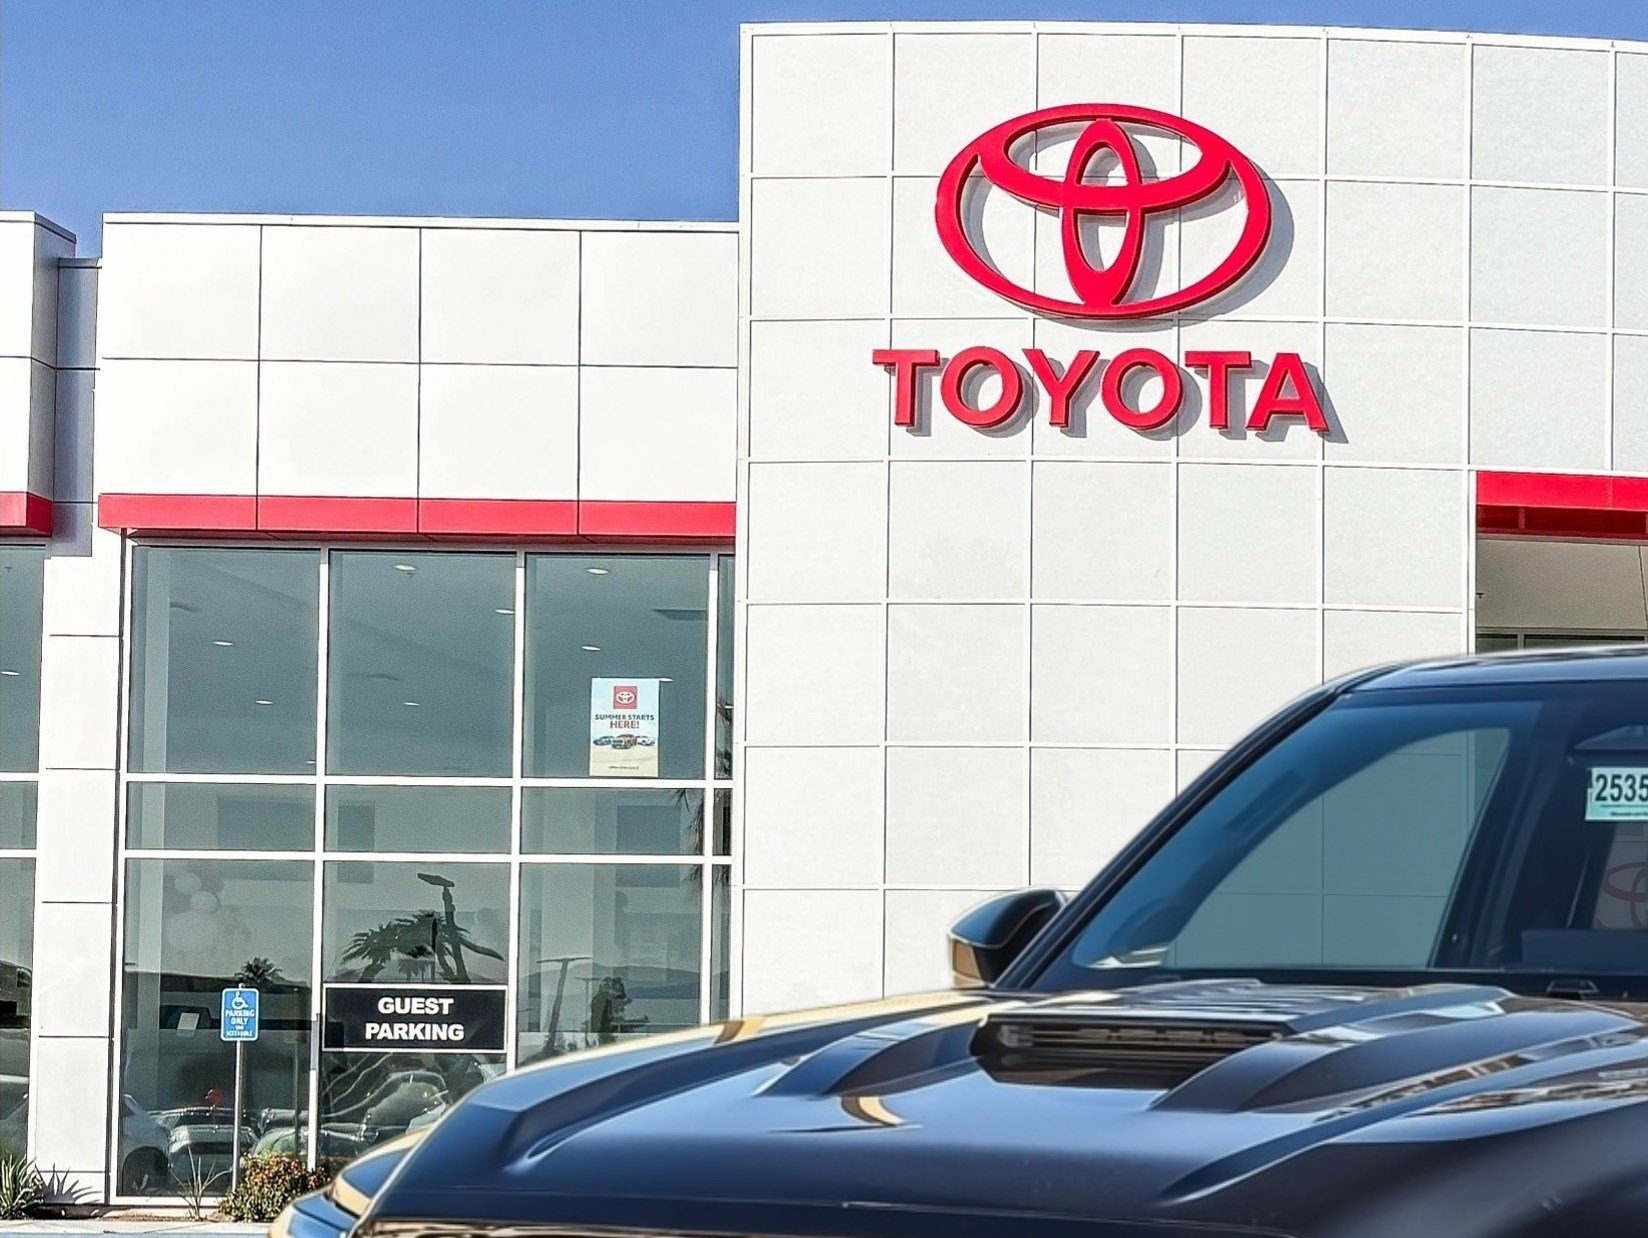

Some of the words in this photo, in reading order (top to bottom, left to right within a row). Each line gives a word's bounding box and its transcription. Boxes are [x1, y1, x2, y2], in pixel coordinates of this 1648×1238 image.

[872, 346, 1331, 434] TOYOTA
[610, 721, 640, 729] HERE!
[377, 997, 454, 1015] GUEST
[365, 1023, 464, 1041] PARKING
